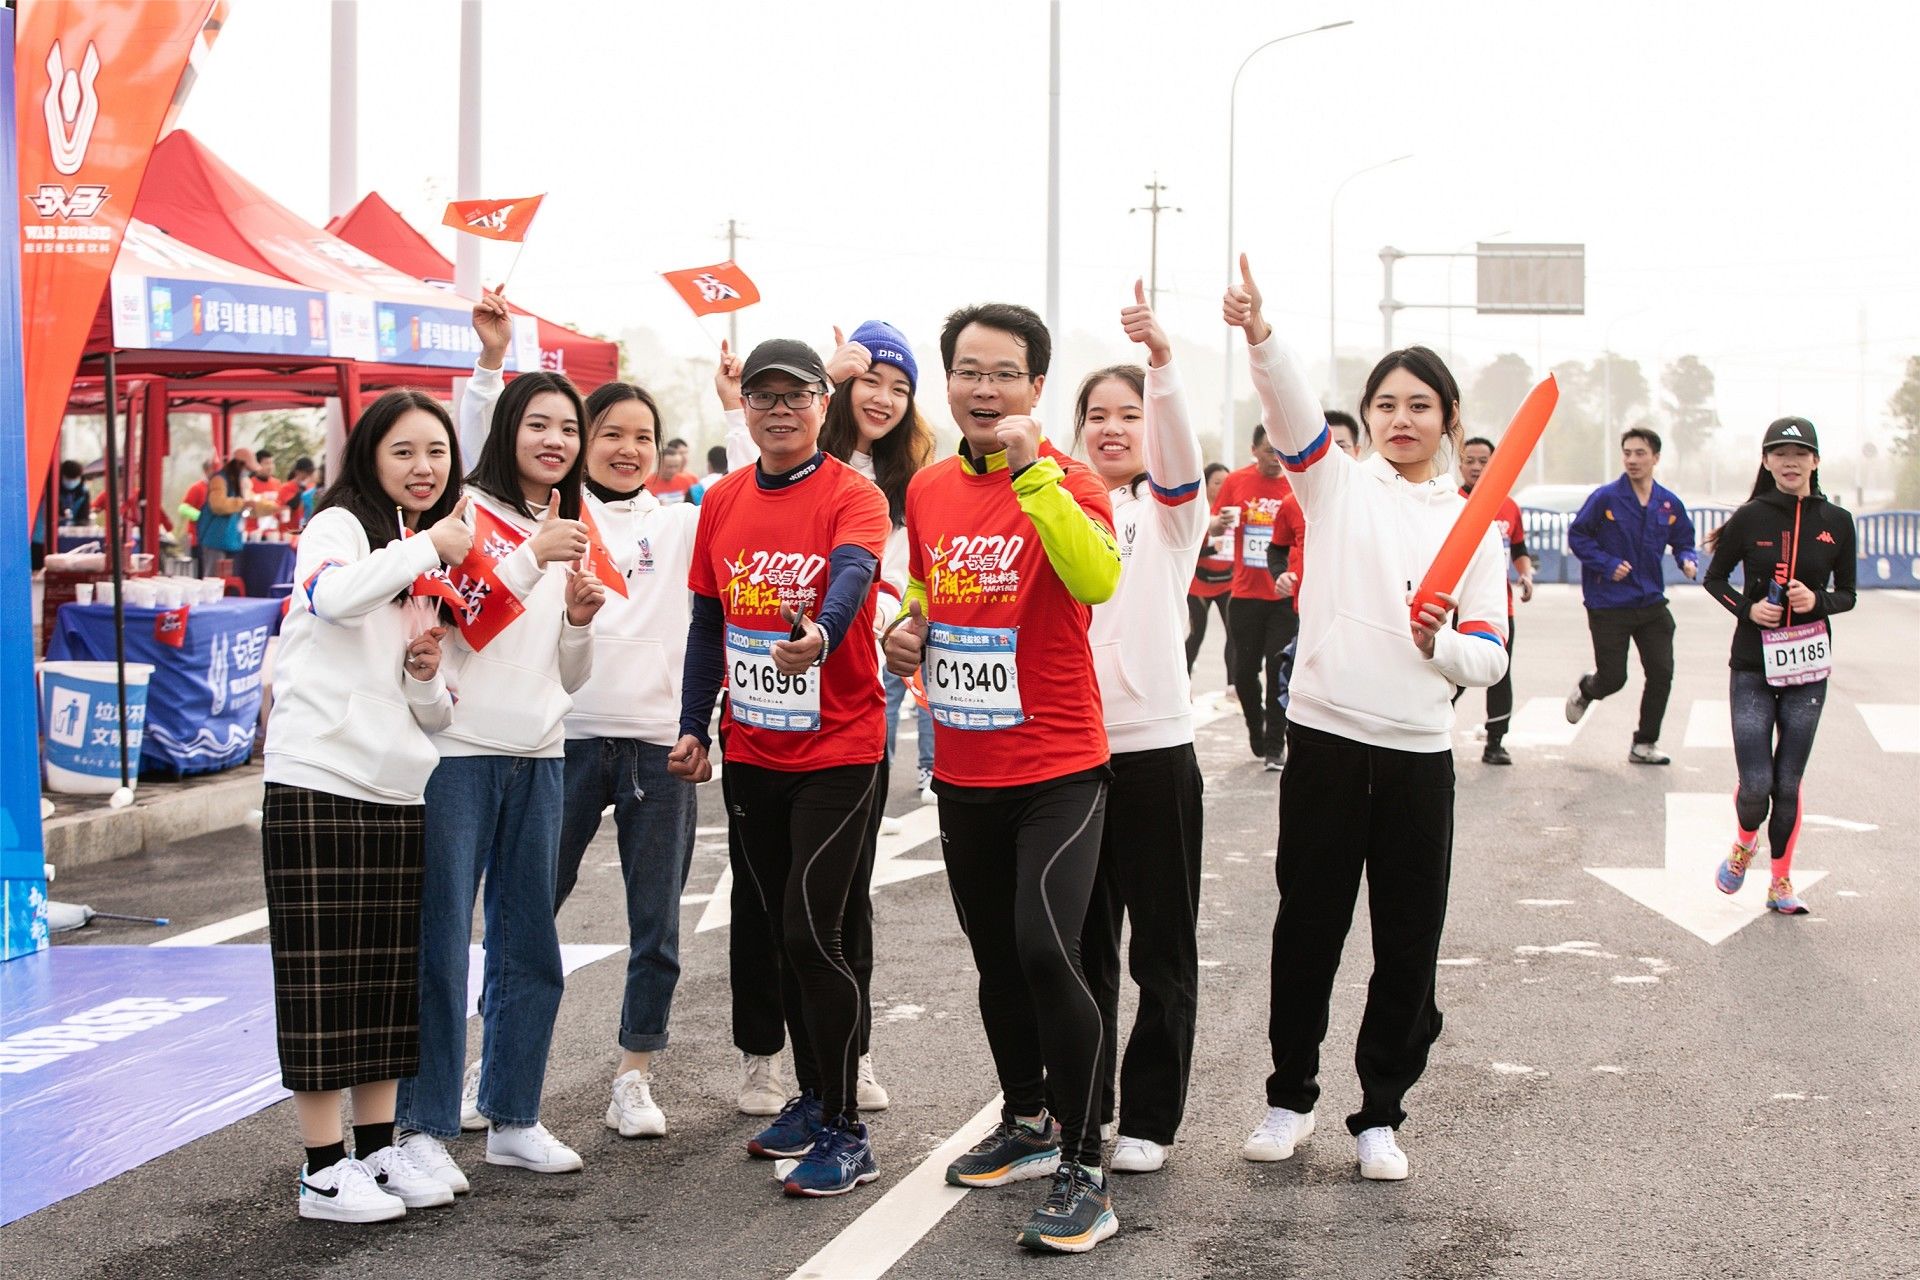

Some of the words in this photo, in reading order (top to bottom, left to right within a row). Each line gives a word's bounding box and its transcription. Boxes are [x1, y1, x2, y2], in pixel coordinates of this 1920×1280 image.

[57, 226, 112, 240] HORSE
[748, 549, 826, 588] 2020
[948, 534, 1024, 573] 2020
[979, 569, 1020, 585] 马拉松赛
[982, 584, 1018, 593] MARATHON
[1775, 642, 1826, 667] D1185
[734, 660, 808, 696] C1696
[936, 658, 1008, 693] C1340
